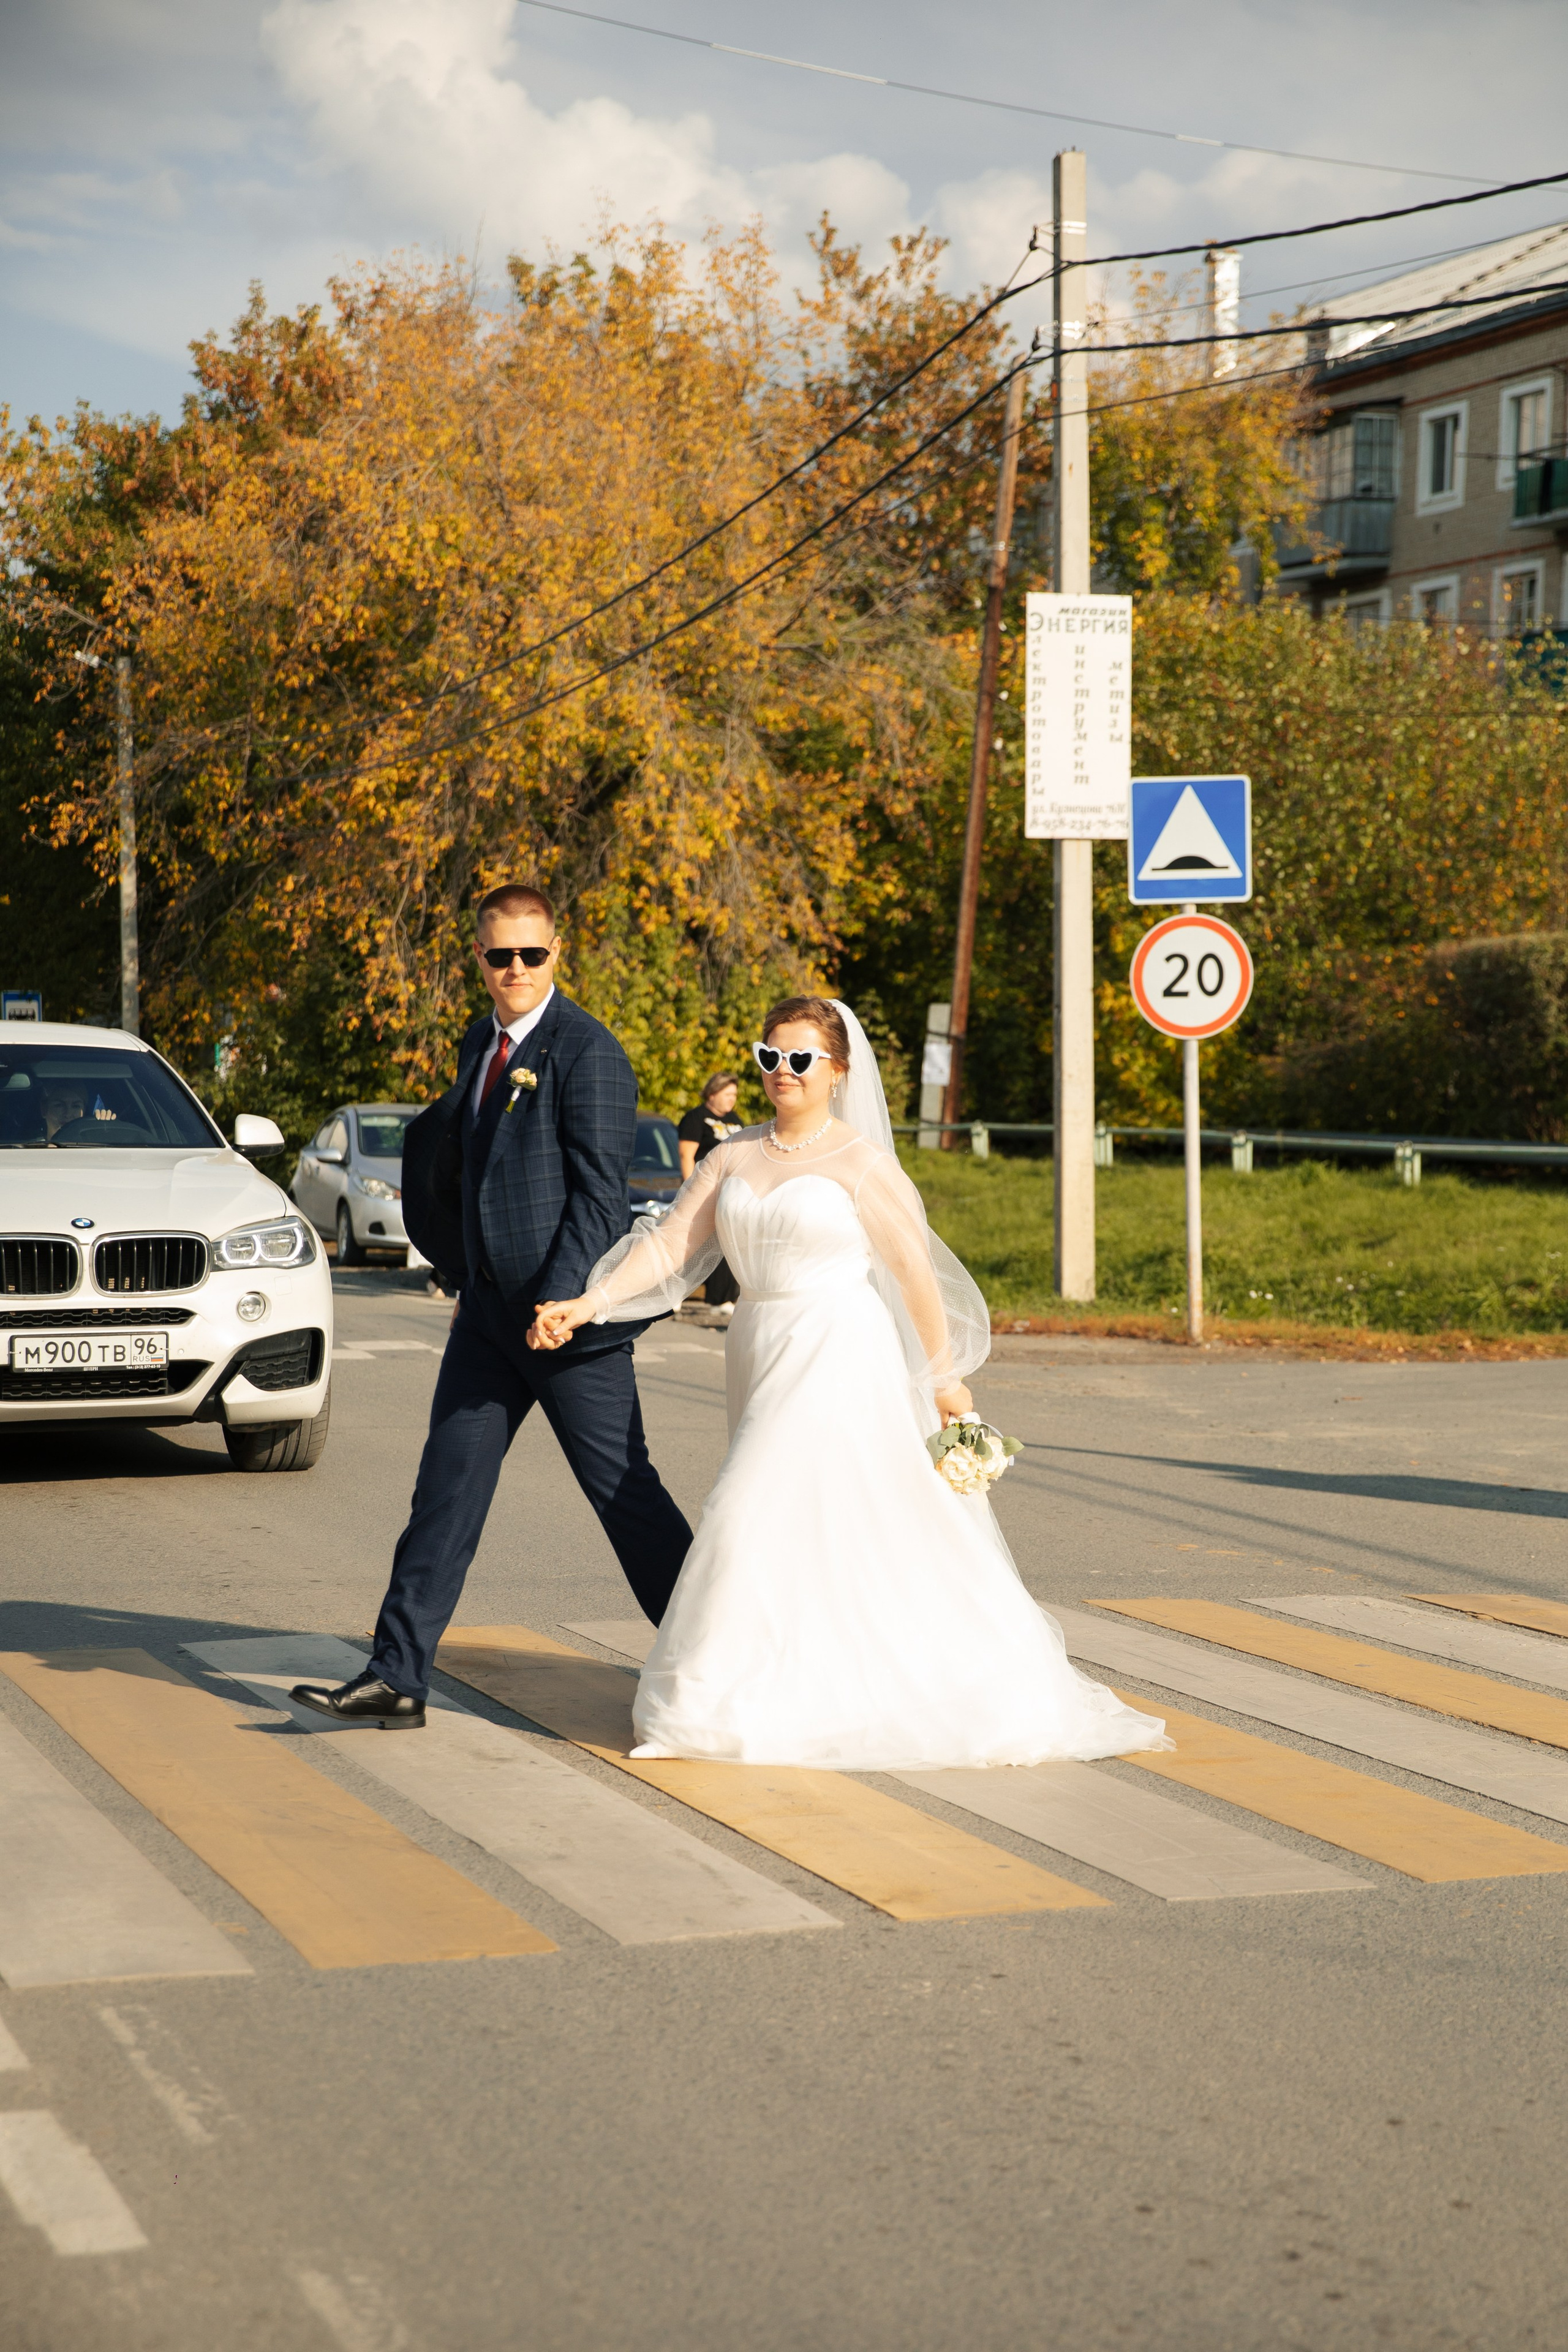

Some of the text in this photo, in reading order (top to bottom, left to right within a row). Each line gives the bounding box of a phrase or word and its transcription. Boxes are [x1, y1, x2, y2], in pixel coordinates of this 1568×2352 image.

[1059, 606, 1127, 616] магазин
[1030, 612, 1128, 634] ЭНЕРГИЯ
[1163, 954, 1223, 997] 20
[135, 1338, 157, 1355] 96
